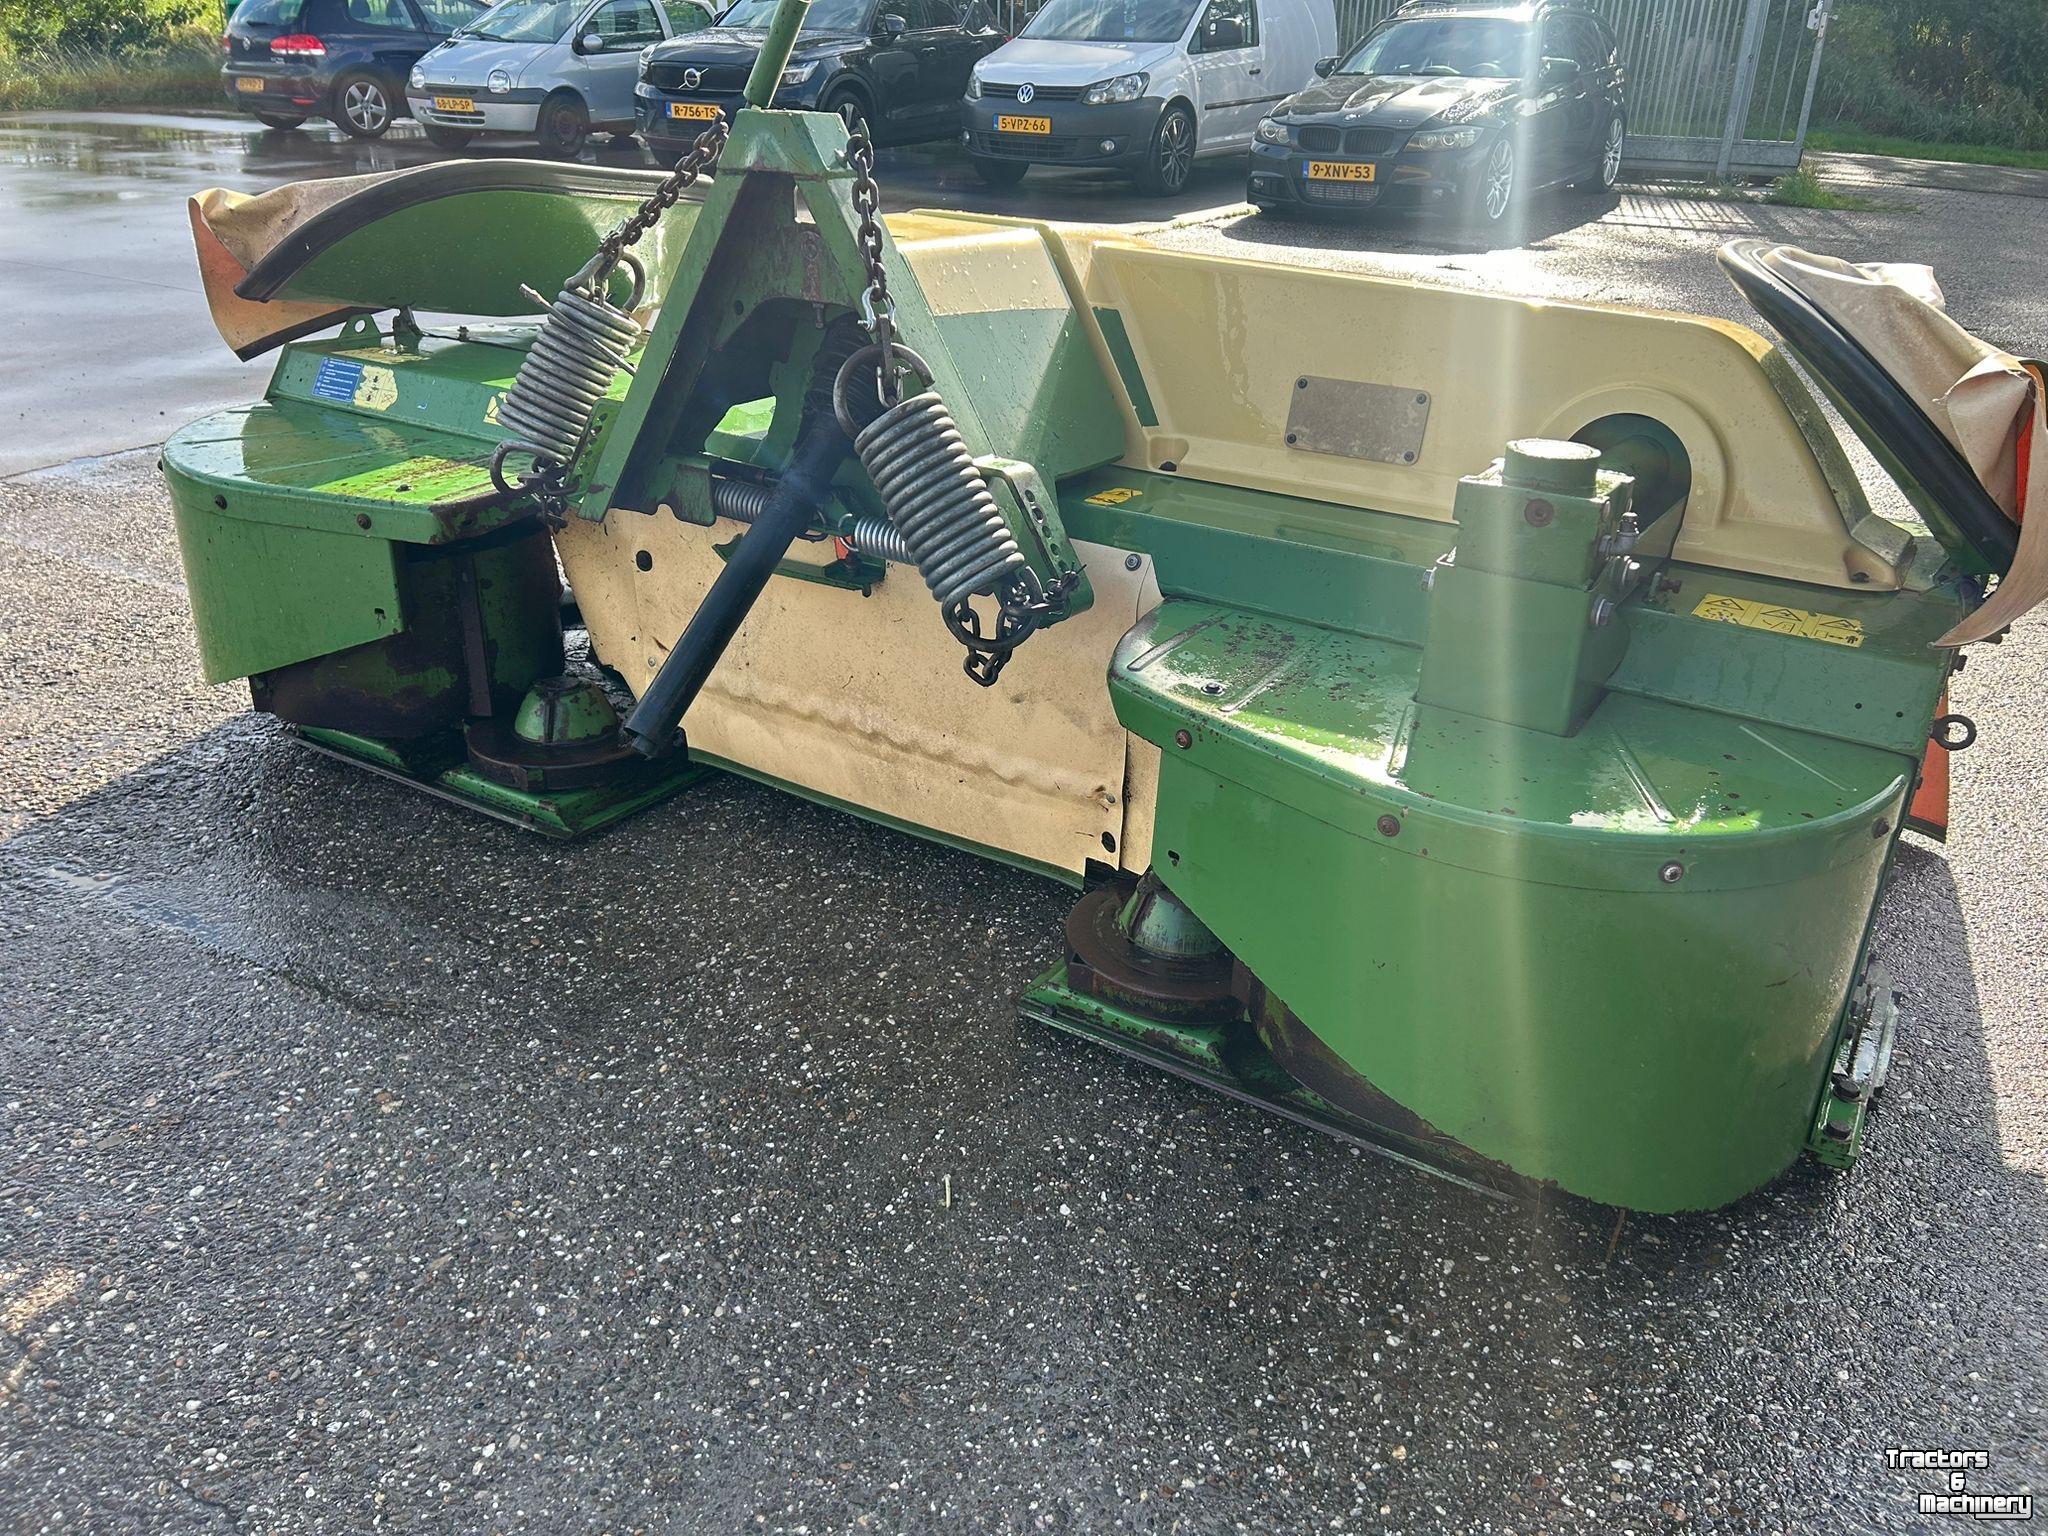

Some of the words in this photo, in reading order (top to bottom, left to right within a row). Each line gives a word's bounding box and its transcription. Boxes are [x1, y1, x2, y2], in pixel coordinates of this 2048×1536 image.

[673, 105, 716, 118] R-756-TS
[1001, 117, 1046, 131] 5-VPZ-66
[1312, 163, 1371, 179] 9-XNV-53
